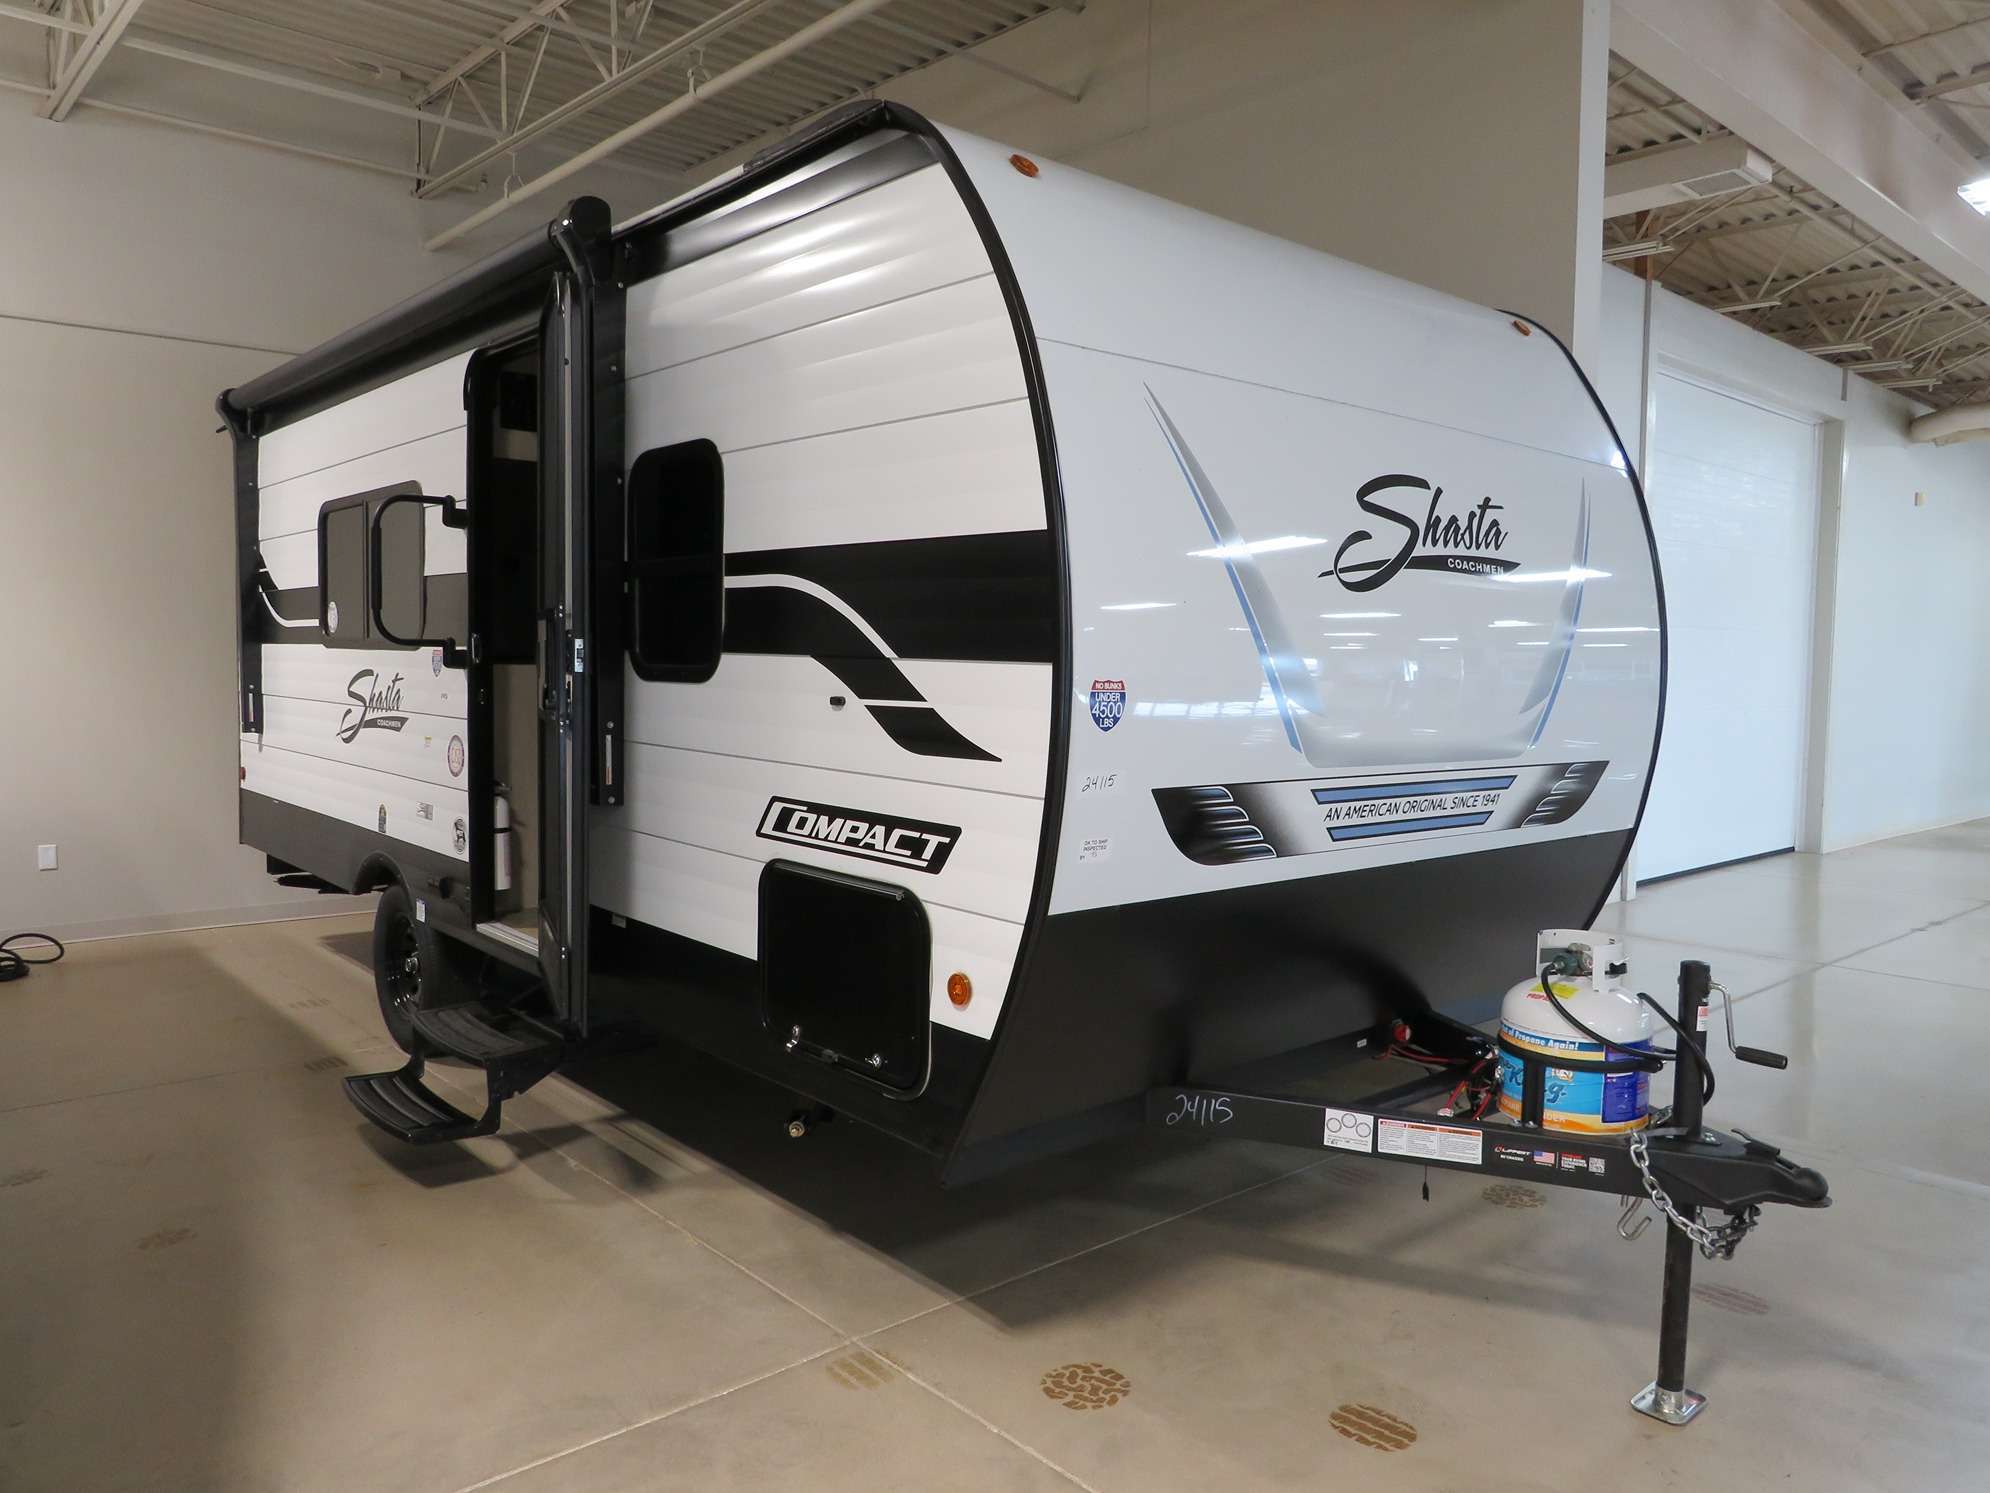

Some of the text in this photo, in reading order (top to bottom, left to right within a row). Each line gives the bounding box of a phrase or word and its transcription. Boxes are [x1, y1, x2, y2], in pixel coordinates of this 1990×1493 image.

[1334, 474, 1508, 592] Shasta
[1447, 557, 1504, 576] COACHMEN
[1095, 682, 1104, 690] NO
[340, 669, 404, 744] Shasta
[1095, 692, 1120, 702] UNDER
[1092, 701, 1122, 718] 4500
[1100, 718, 1114, 728] LBS
[1081, 774, 1117, 793] 24115
[1324, 793, 1501, 822] AN AMERICAN ORIGINAL SINCE 1941
[760, 801, 950, 867] COMPACT
[1515, 1031, 1546, 1047] Propane
[1547, 1039, 1579, 1051] Again!
[1166, 1094, 1233, 1127] 24115
